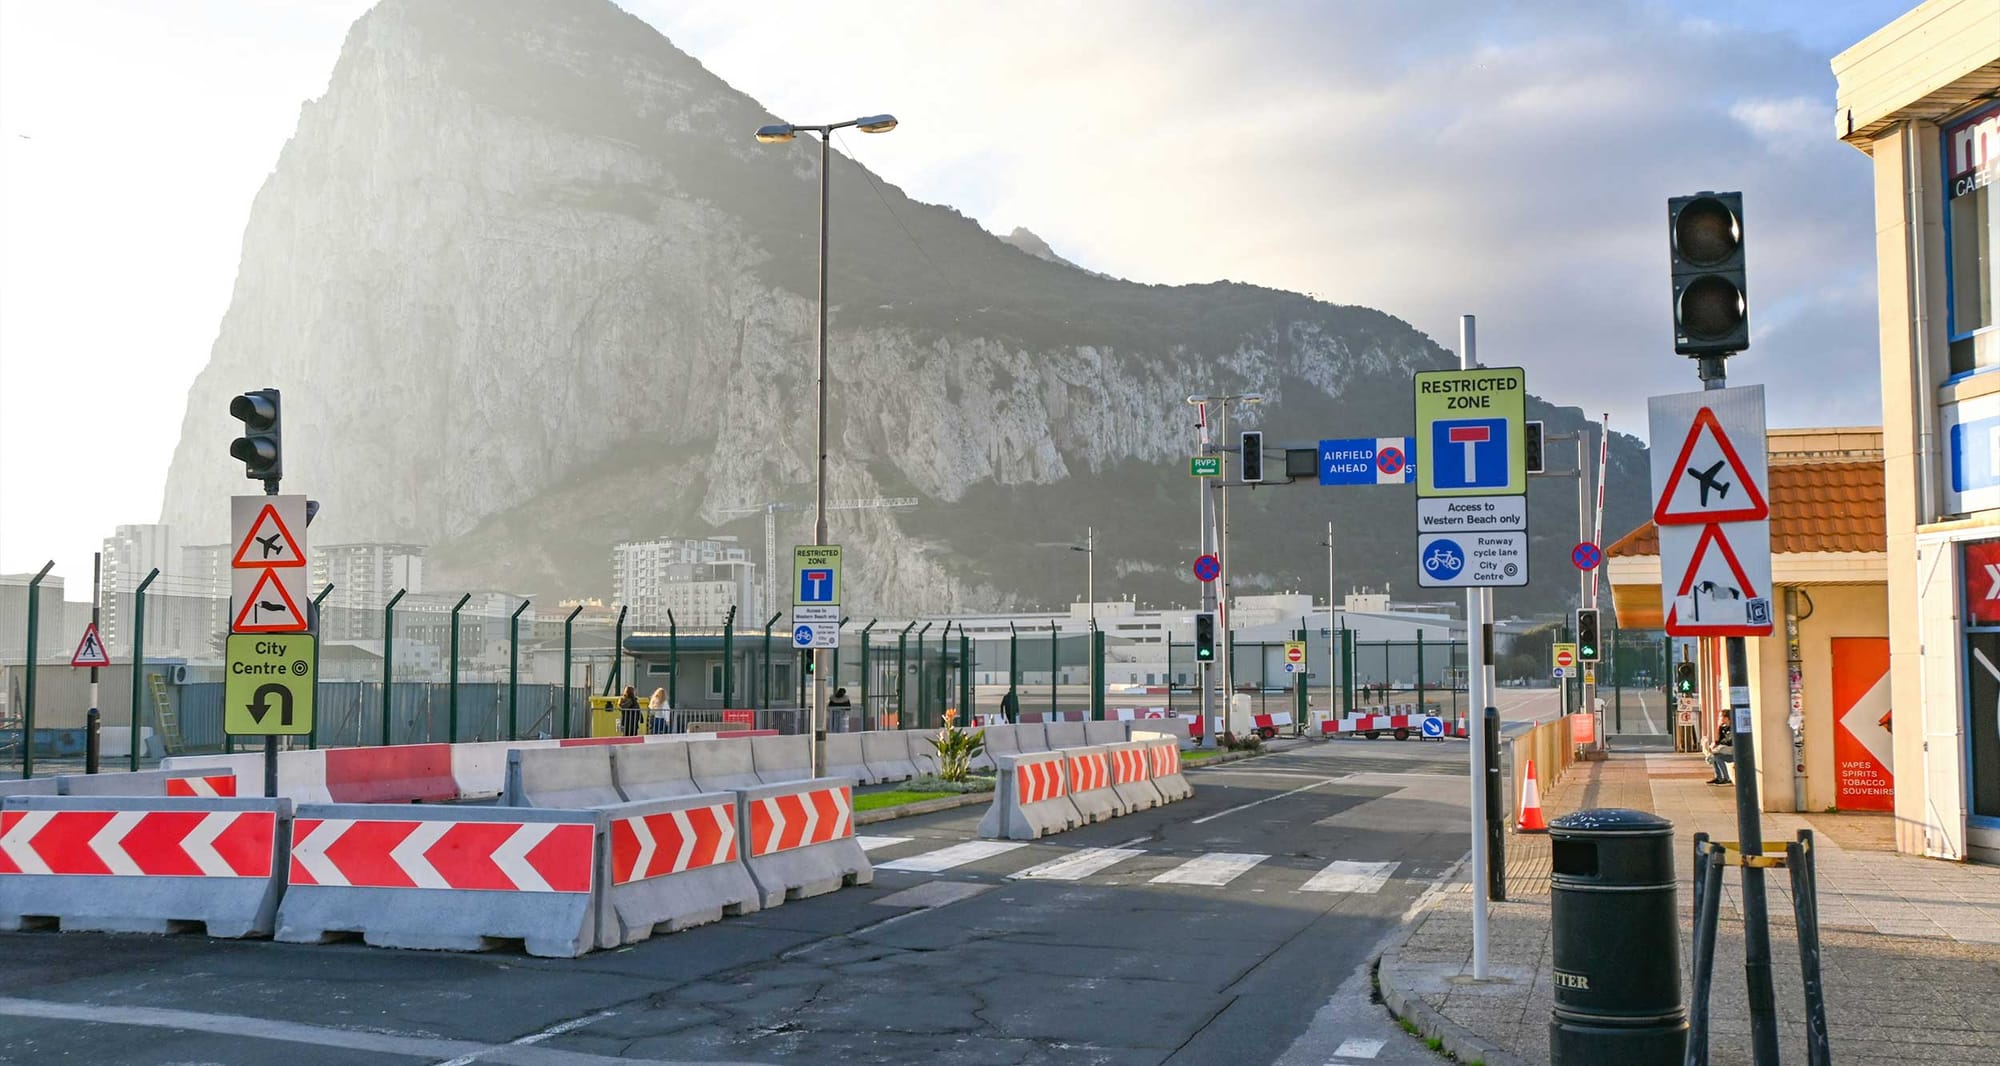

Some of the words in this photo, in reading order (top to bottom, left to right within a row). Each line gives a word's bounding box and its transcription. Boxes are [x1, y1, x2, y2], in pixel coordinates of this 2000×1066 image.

[1421, 378, 1518, 394] RESTRICTED
[1447, 396, 1490, 409] ZONE
[1324, 450, 1373, 461] AIRFIELD
[1330, 464, 1368, 473] AHEAD
[1448, 503, 1482, 512] Access
[1485, 503, 1495, 511] to
[1424, 516, 1464, 525] Western
[1467, 515, 1497, 524] Beach
[1500, 514, 1521, 525] only
[1478, 538, 1513, 546] Runway
[1474, 549, 1497, 558] cycle
[1480, 561, 1498, 570] City
[255, 641, 287, 657] City
[232, 661, 287, 675] Centre
[1842, 761, 1871, 769] VAPES
[1842, 770, 1878, 778] SPIRITS
[1842, 779, 1886, 787] TOBACCO
[1843, 787, 1894, 796] SOUVENIRS
